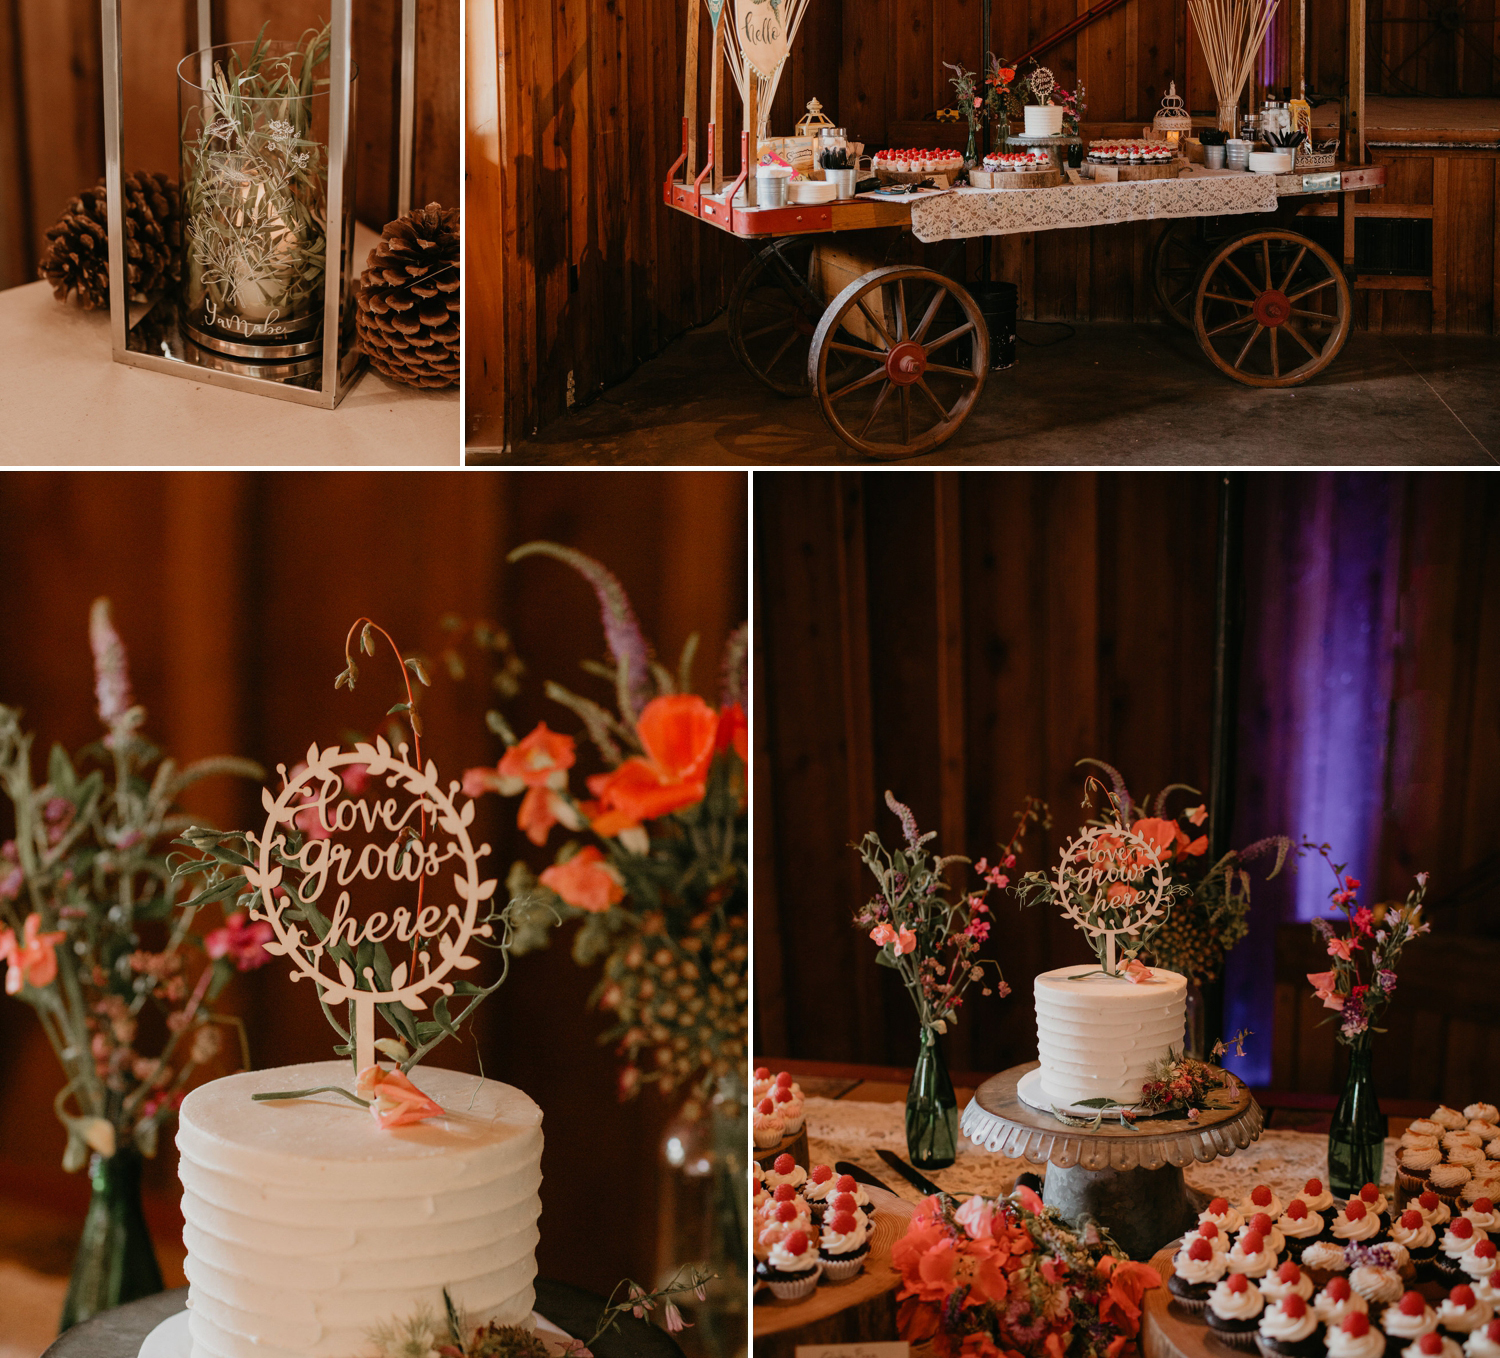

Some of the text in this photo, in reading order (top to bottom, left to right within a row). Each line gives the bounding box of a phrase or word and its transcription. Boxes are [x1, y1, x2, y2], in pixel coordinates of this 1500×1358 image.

[742, 12, 780, 45] hello
[295, 773, 425, 833] love
[1084, 839, 1134, 864] love
[295, 838, 441, 904] grows
[1077, 863, 1146, 895] grows
[1091, 888, 1152, 914] here
[318, 890, 451, 948] here
